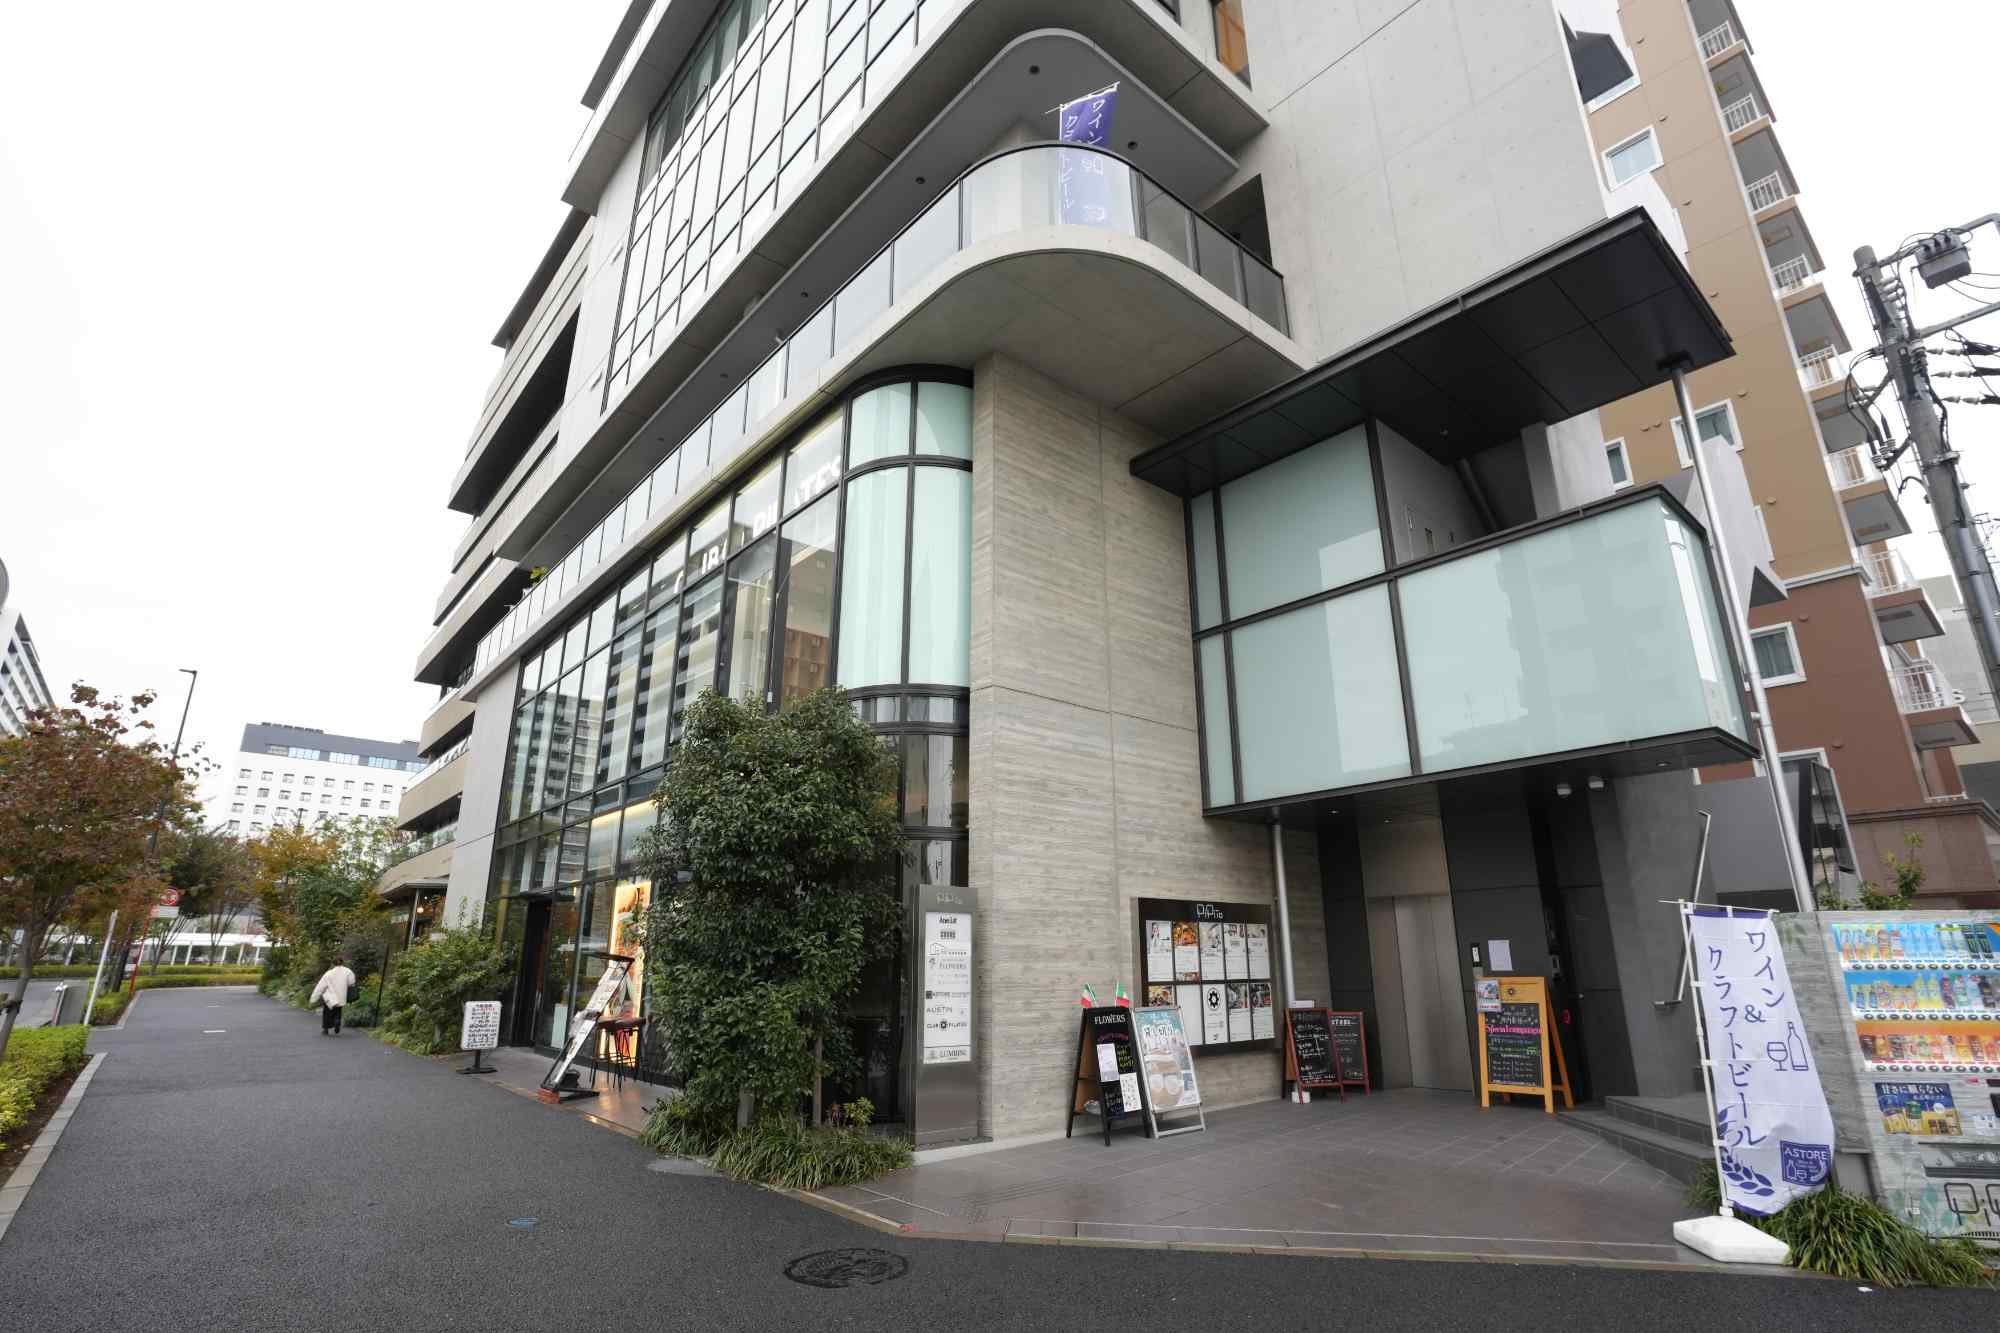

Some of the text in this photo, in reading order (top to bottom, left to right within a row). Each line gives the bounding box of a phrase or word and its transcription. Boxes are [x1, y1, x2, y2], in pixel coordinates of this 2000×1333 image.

[1087, 98, 1106, 146] ワイン
[1094, 1014, 1126, 1025] FLOWERS
[1707, 944, 1768, 1147] クラフトビール
[1784, 1147, 1828, 1160] ASTORE
